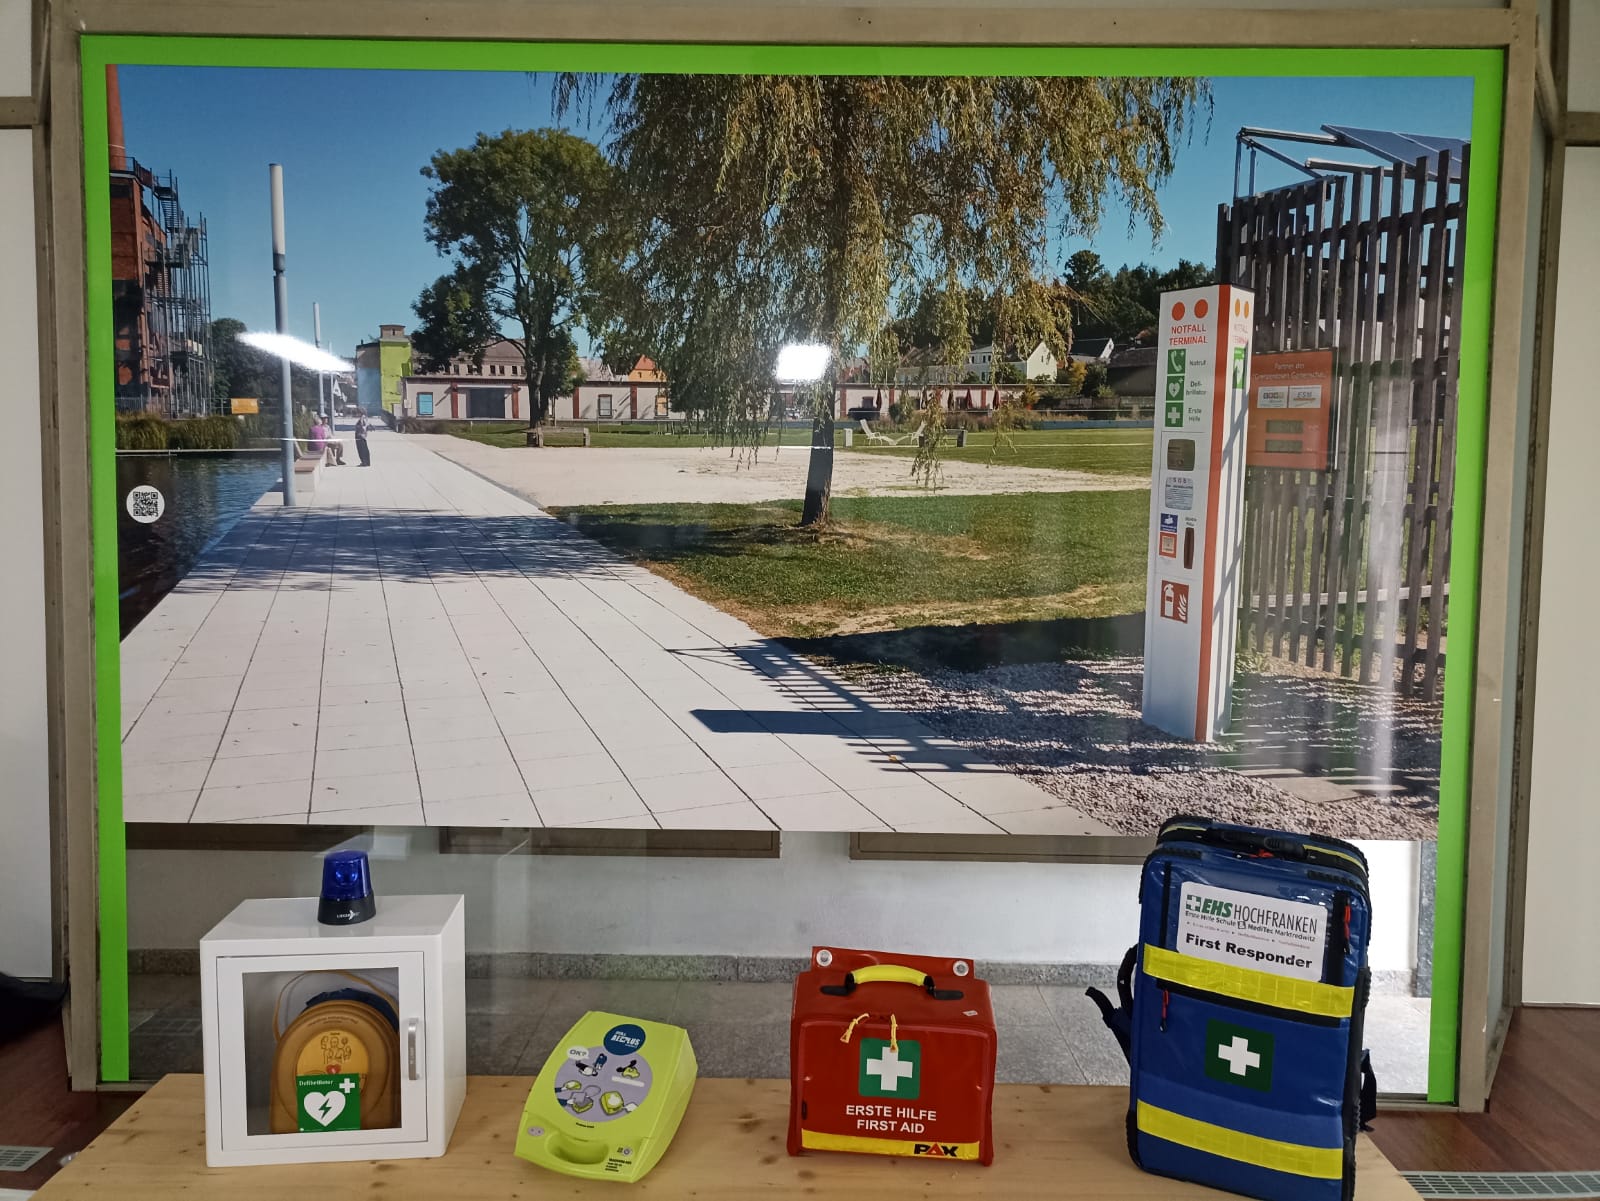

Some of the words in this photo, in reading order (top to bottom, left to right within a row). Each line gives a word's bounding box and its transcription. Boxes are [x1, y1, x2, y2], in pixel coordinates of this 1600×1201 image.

[1171, 324, 1206, 334] NOTFALL
[1169, 336, 1208, 346] TERMINAL
[1202, 898, 1233, 918] EHS
[1233, 904, 1318, 934] HOCHFRANKEN
[1216, 917, 1237, 926] Schule
[1185, 932, 1221, 951] First
[1225, 941, 1313, 968] Responder
[846, 1105, 893, 1118] ERSTE
[896, 1107, 937, 1121] HILFE
[857, 1119, 898, 1132] FIRST
[900, 1121, 925, 1134] AID
[913, 1143, 959, 1158] PAX
